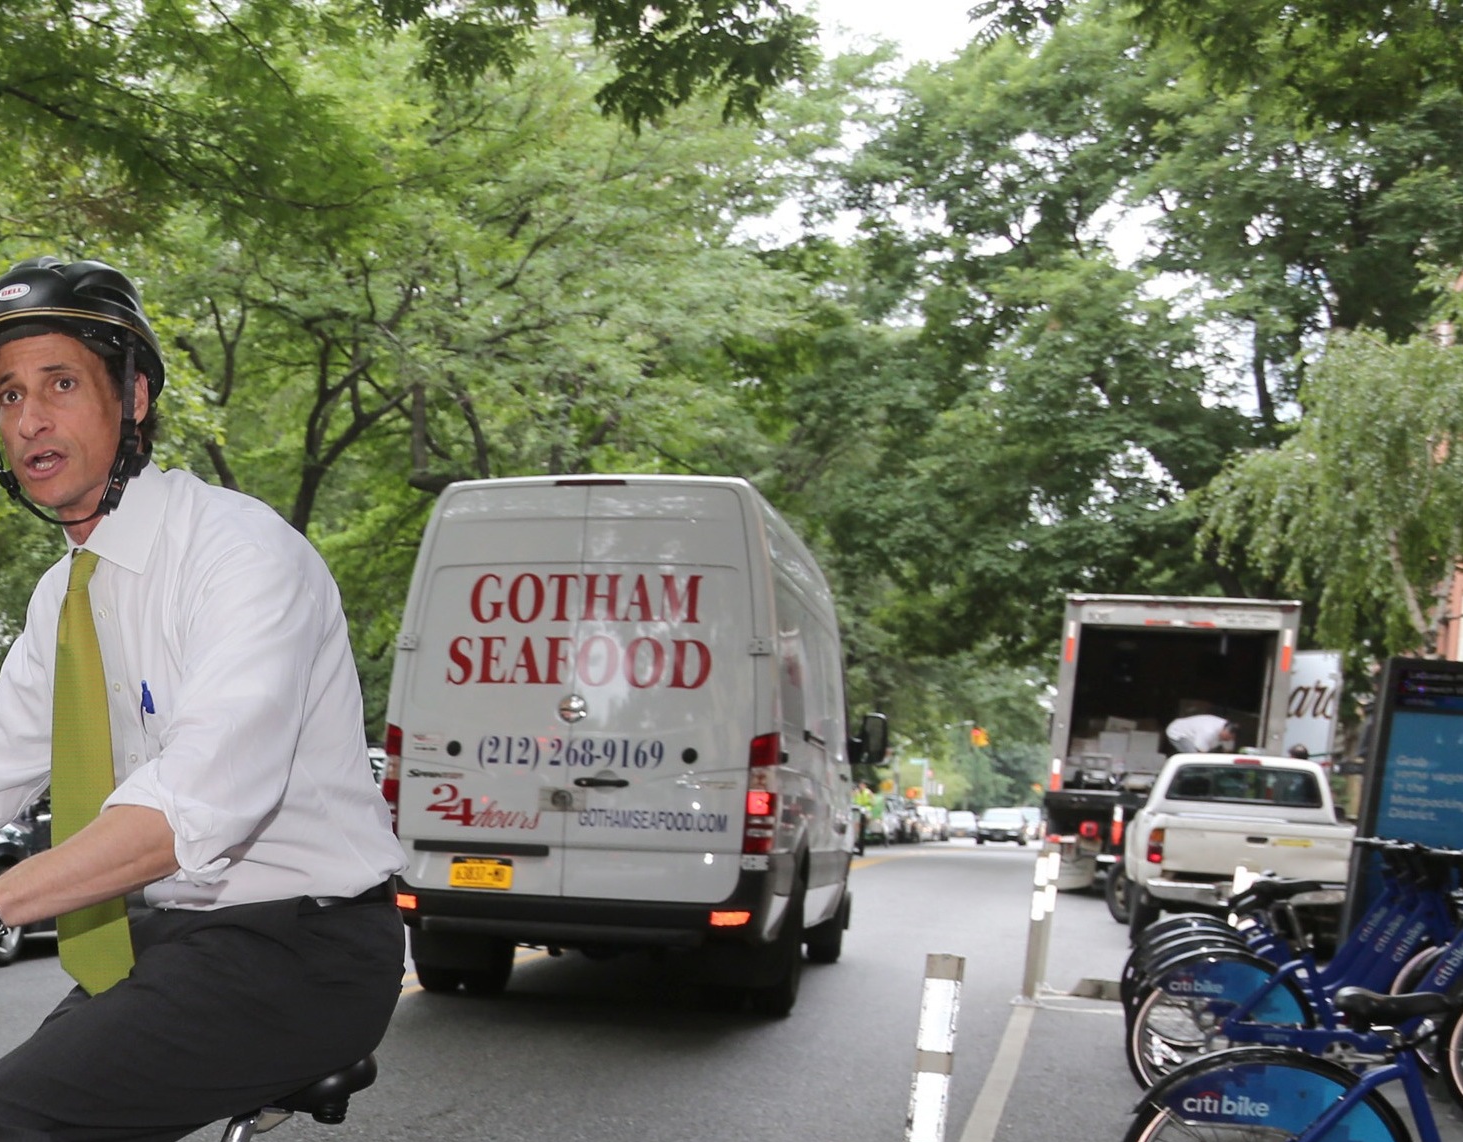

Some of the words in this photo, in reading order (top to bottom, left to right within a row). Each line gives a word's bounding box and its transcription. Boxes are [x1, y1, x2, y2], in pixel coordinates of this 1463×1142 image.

[1, 287, 23, 297] BELL
[470, 572, 704, 624] GOTHAM
[445, 635, 712, 690] SEAFOOD
[477, 735, 540, 771] (212)
[548, 737, 665, 769] 268-9169
[425, 783, 476, 827] 24
[578, 808, 728, 833] GOTHAMSEAFOOD.COM
[1169, 976, 1193, 992] citi
[1193, 980, 1224, 994] bike
[1182, 1091, 1220, 1114] citi
[1221, 1094, 1270, 1118] bike
